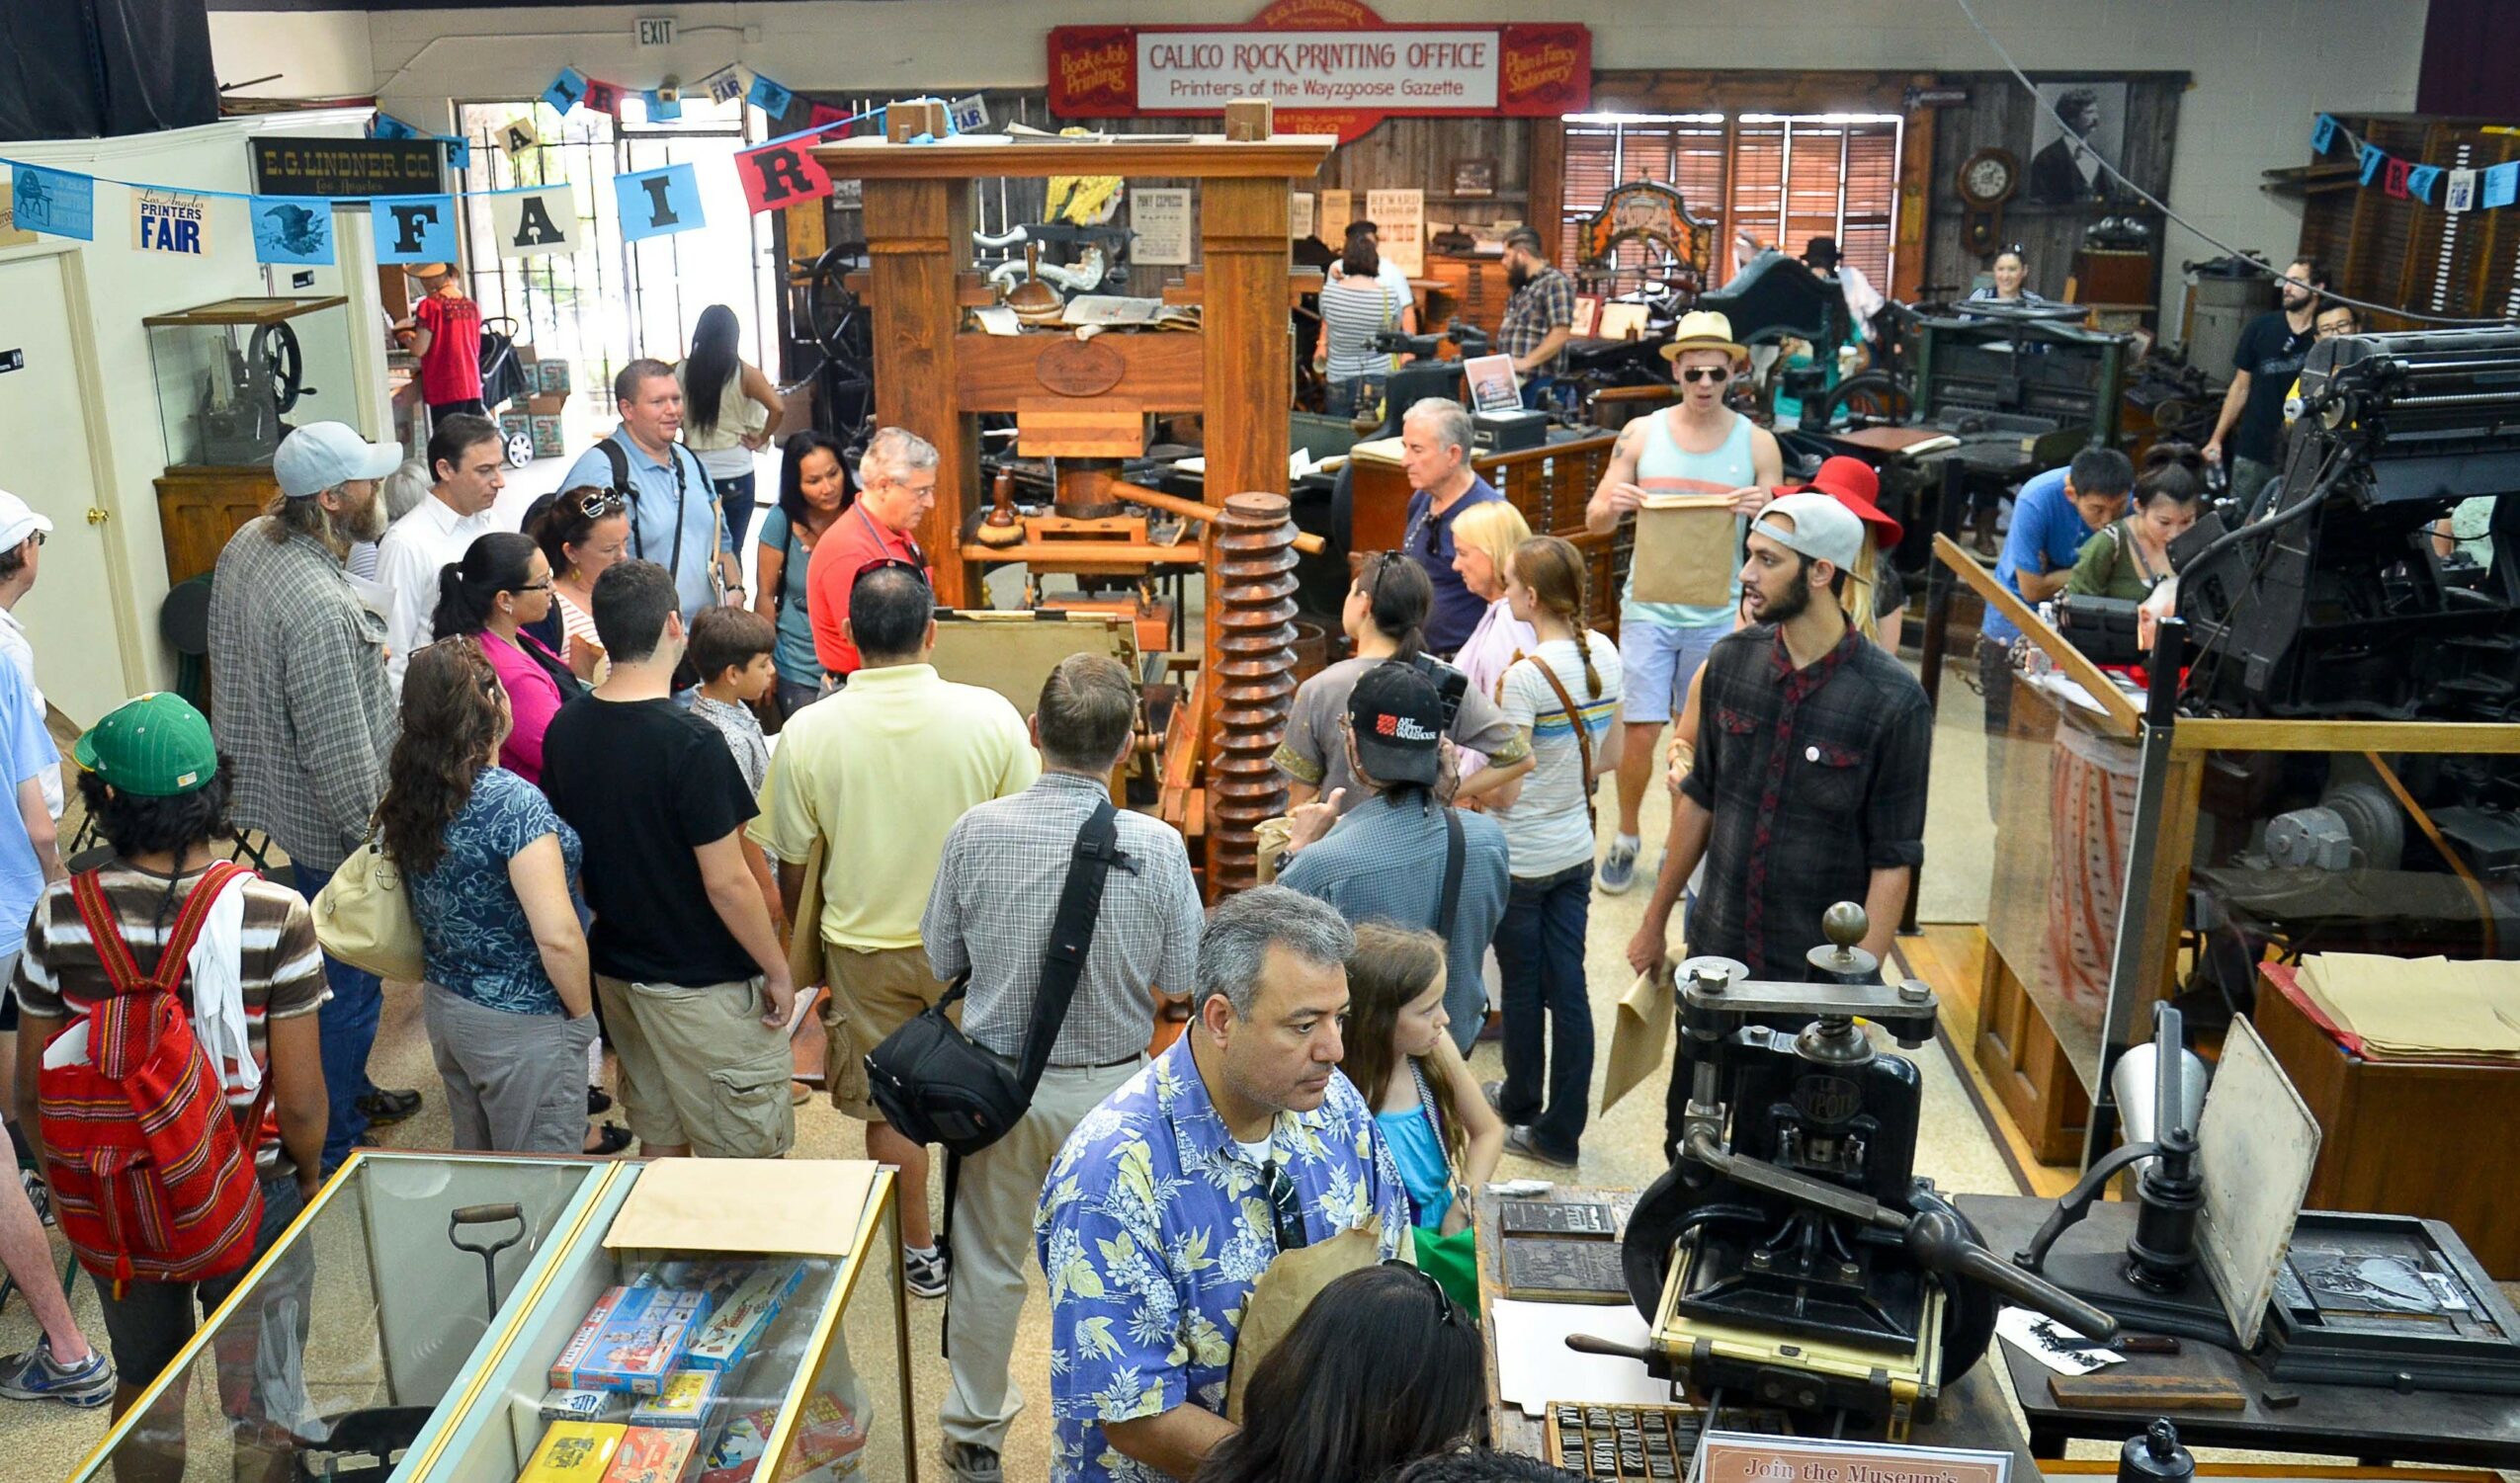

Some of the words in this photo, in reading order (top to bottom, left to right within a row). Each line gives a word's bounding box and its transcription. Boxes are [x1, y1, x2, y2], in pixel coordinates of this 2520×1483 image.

[640, 20, 671, 44] EXIT
[1061, 49, 1098, 75] Book
[1104, 45, 1128, 63] Job
[1150, 44, 1223, 69] CALICO
[1233, 43, 1297, 75] ROCK
[1297, 42, 1395, 75] PRINTING
[1408, 42, 1485, 69] OFFICE
[1506, 51, 1535, 74] Plain
[1543, 44, 1576, 66] Fancy
[1067, 67, 1127, 95] Printing
[1170, 80, 1243, 96] Printers
[1249, 79, 1266, 96] of
[1273, 80, 1299, 96] the
[1303, 80, 1394, 100] Wayzgoose
[1401, 79, 1464, 96] Gazette
[509, 126, 532, 152] A
[553, 79, 577, 104] I
[593, 85, 614, 112] R
[304, 151, 399, 178] LINDNER
[138, 189, 160, 205] Los
[159, 191, 205, 209] Angeles
[315, 179, 333, 195] Los
[340, 179, 385, 194] Angeles
[141, 204, 202, 220] PRINTERS
[389, 205, 439, 253] F
[513, 196, 565, 247] A
[640, 175, 679, 227] I
[752, 147, 815, 202] R
[1371, 195, 1420, 206] REWARD
[141, 215, 202, 255] FAIR
[1397, 716, 1416, 727] ART
[1397, 723, 1424, 734] SUPPLY
[1396, 729, 1437, 740] WAREHOUSE
[556, 1326, 595, 1368] PRINTING
[588, 1306, 608, 1324] SET
[1744, 1458, 1794, 1480] Join
[1803, 1462, 1838, 1482] the
[1847, 1465, 1959, 1483] Museum's
